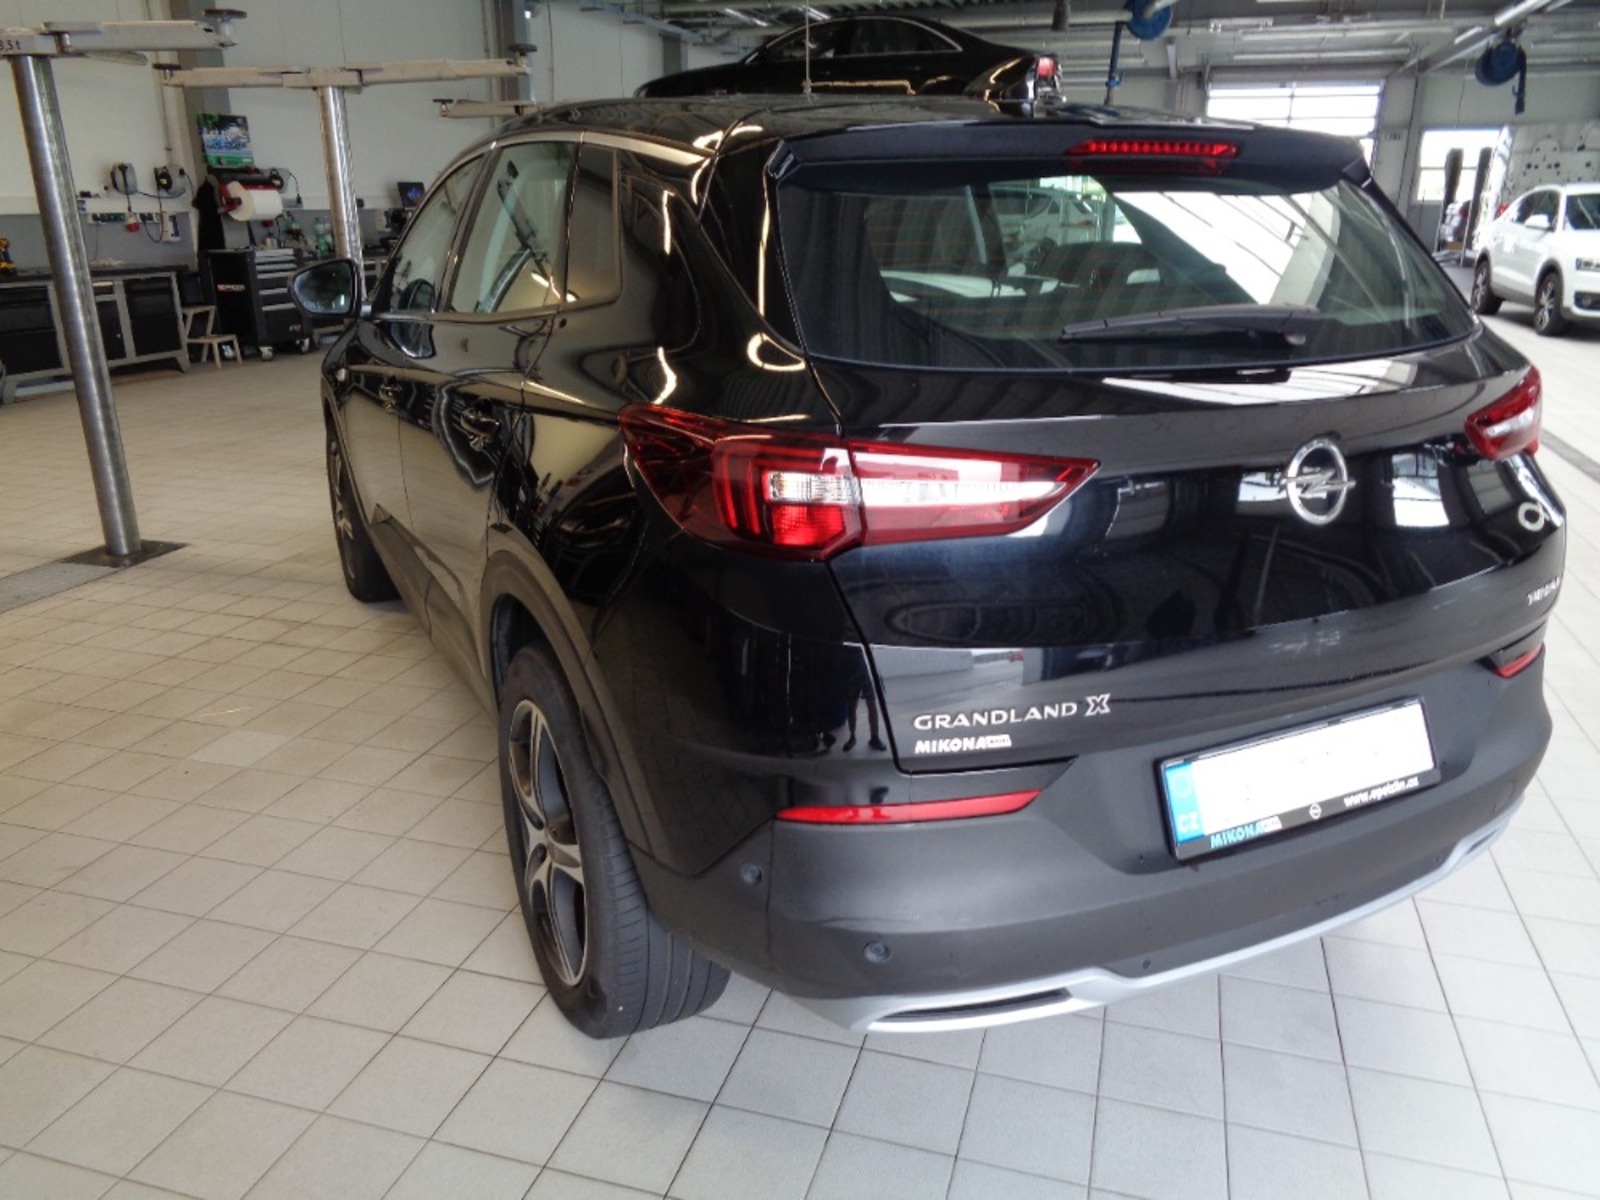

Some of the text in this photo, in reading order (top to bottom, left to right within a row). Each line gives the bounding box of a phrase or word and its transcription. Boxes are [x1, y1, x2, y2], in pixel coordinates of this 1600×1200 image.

[913, 693, 1111, 730] GRANDLAND X
[914, 736, 987, 754] MIKONA
[1177, 811, 1201, 833] CZ
[1210, 822, 1265, 849] MIKONA
